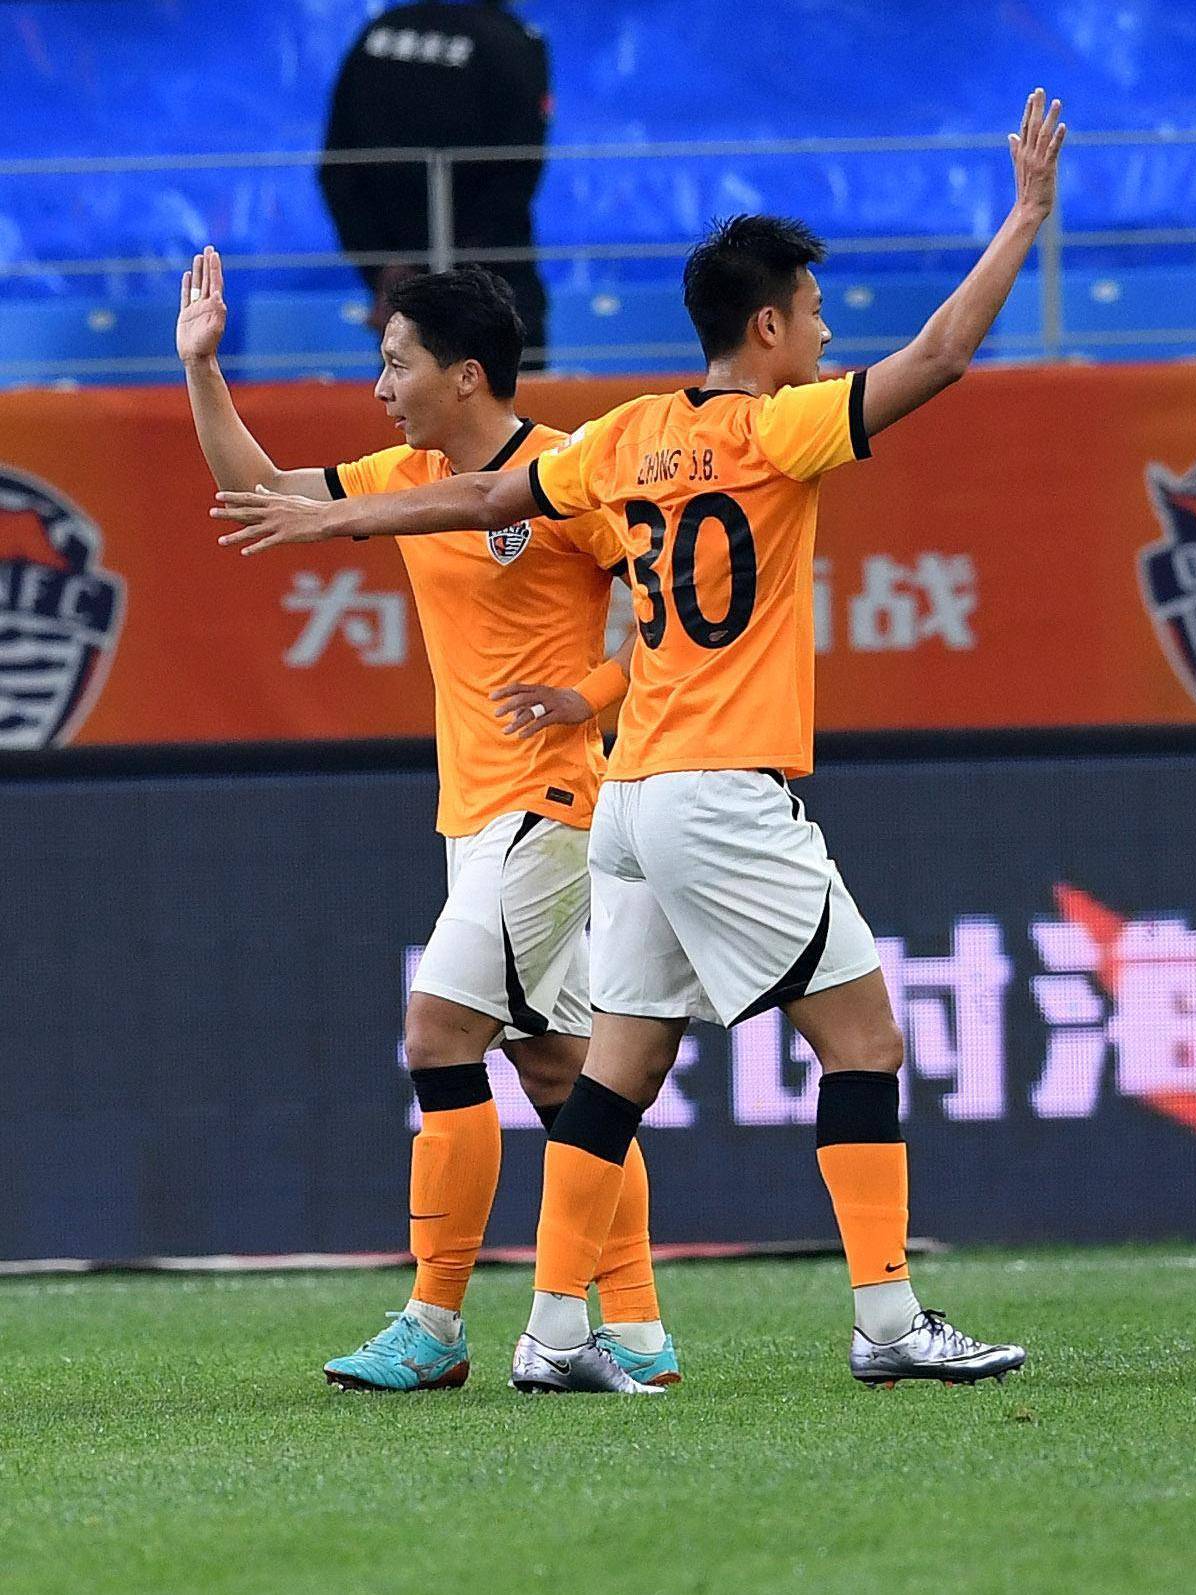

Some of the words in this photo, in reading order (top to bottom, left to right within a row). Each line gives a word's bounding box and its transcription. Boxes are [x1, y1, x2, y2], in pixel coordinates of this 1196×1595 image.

[689, 448, 719, 481] J.B.
[281, 568, 408, 667] 为
[814, 553, 979, 652] 战
[625, 492, 758, 650] 30
